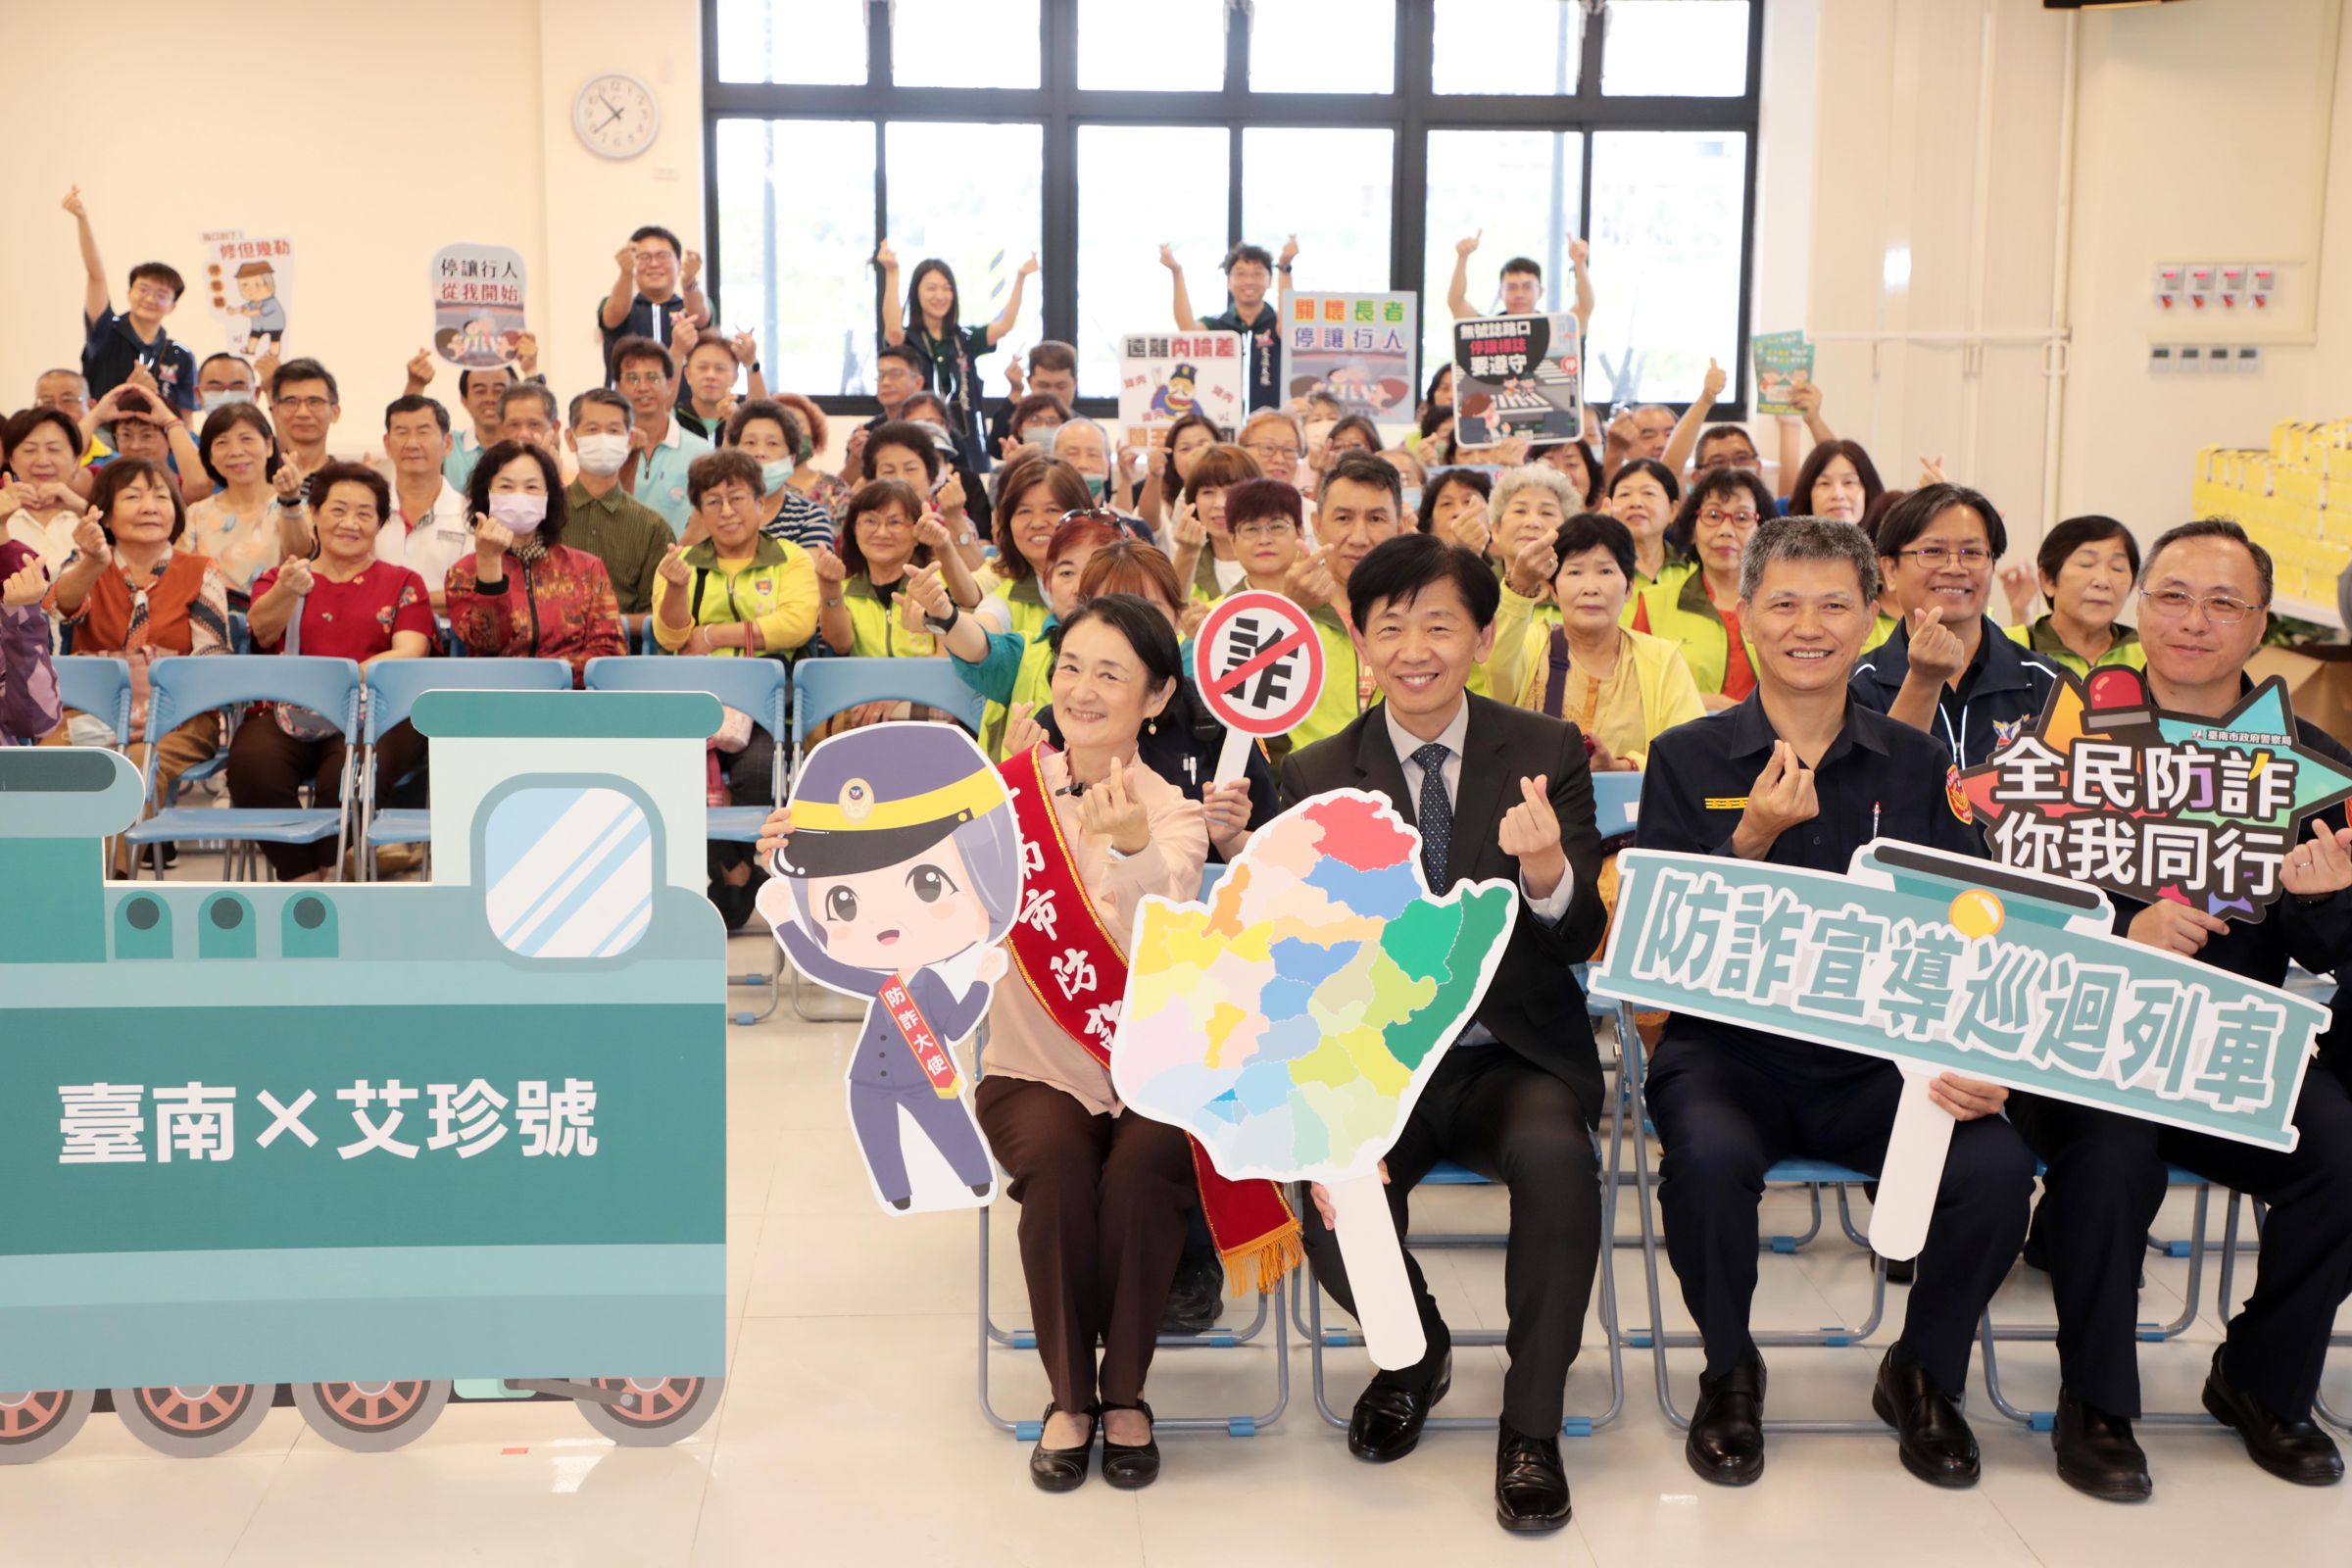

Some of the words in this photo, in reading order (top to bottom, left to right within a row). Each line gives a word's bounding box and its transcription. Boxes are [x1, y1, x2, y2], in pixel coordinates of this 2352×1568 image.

[440, 258, 518, 279] 停讓行人
[441, 281, 518, 303] 從我開始
[1295, 297, 1404, 322] 關懷長者
[1127, 337, 1235, 358] 遠離內輪差
[1294, 326, 1403, 350] 停讓行人
[1470, 354, 1528, 376] 要遵守
[1221, 616, 1299, 710] 詐
[2207, 729, 2291, 746] 臺南市政府警察局
[1993, 736, 2293, 818] 全民防詐
[1994, 811, 2284, 896] 你我同行
[1638, 872, 2281, 1105] 防詐宣導巡迴列車
[884, 986, 948, 1076] 防詐大使
